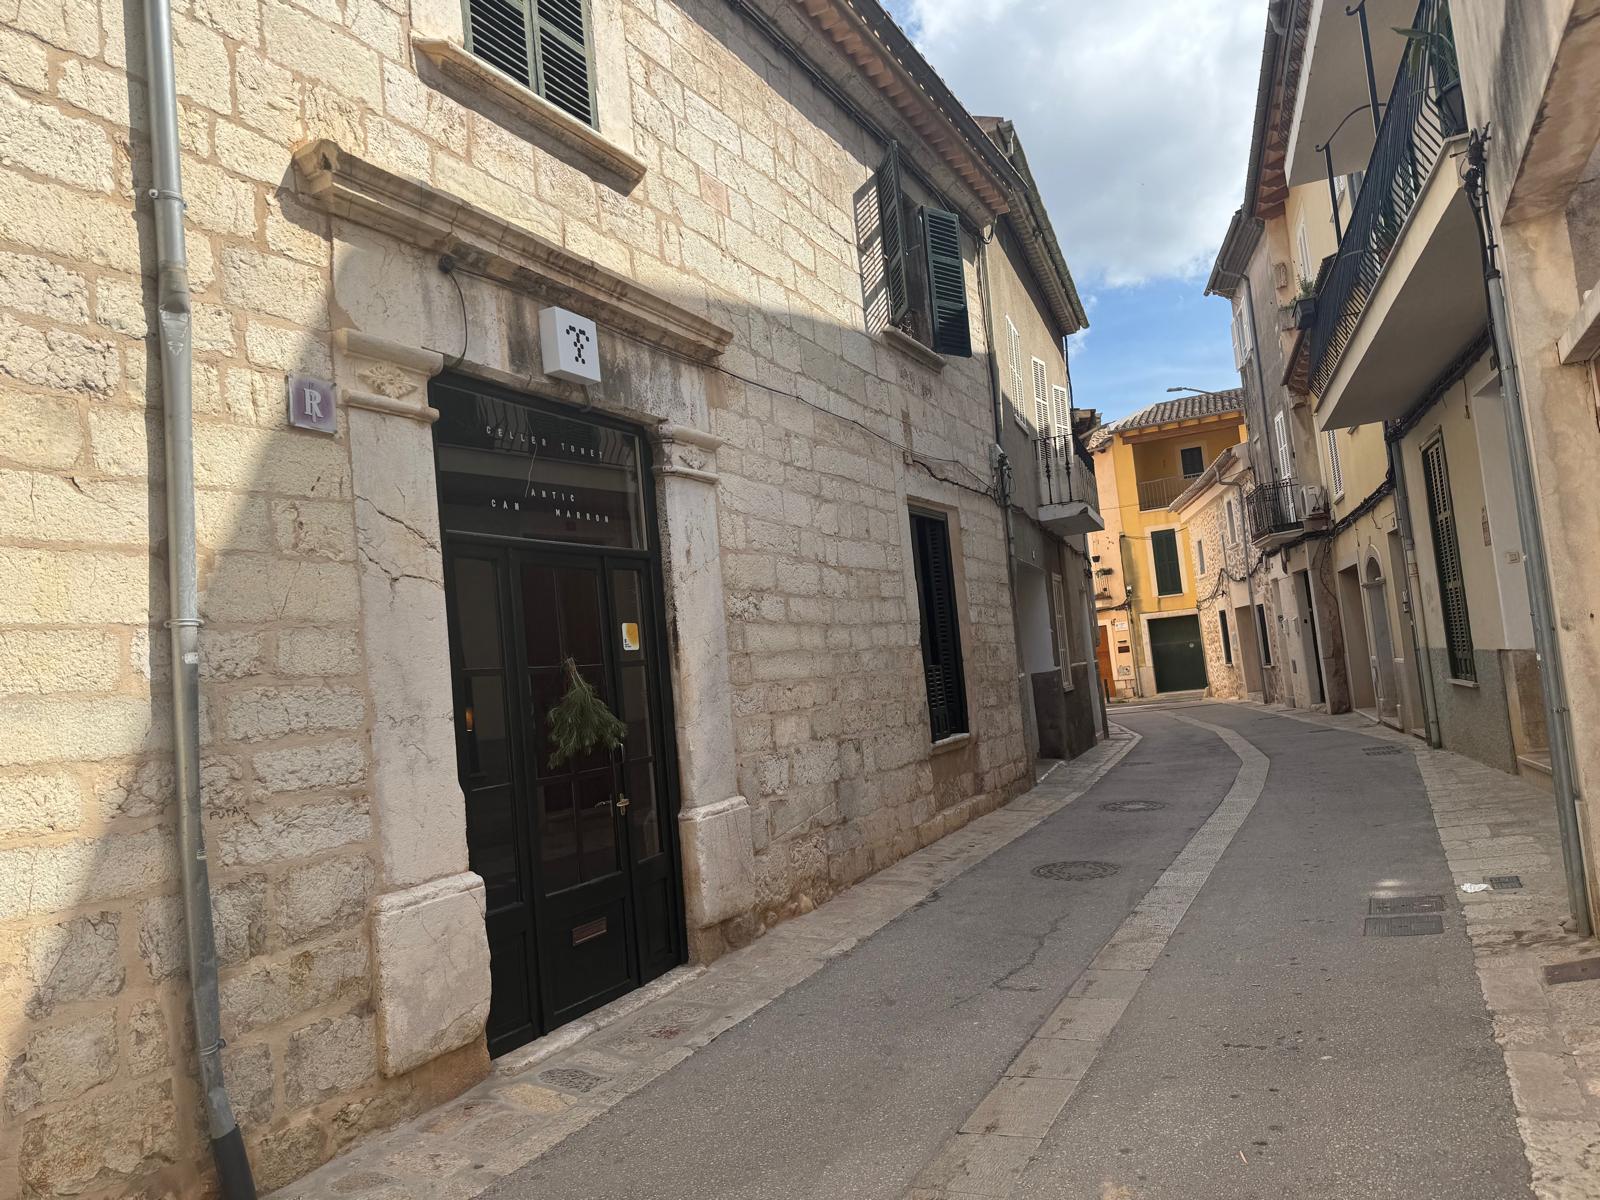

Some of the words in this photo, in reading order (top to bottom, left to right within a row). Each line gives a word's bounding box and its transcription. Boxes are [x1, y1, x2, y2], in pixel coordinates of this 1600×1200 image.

[303, 387, 324, 419] R
[486, 425, 547, 447] CELLER
[561, 442, 603, 459] TONET
[530, 487, 576, 502] ANTIC
